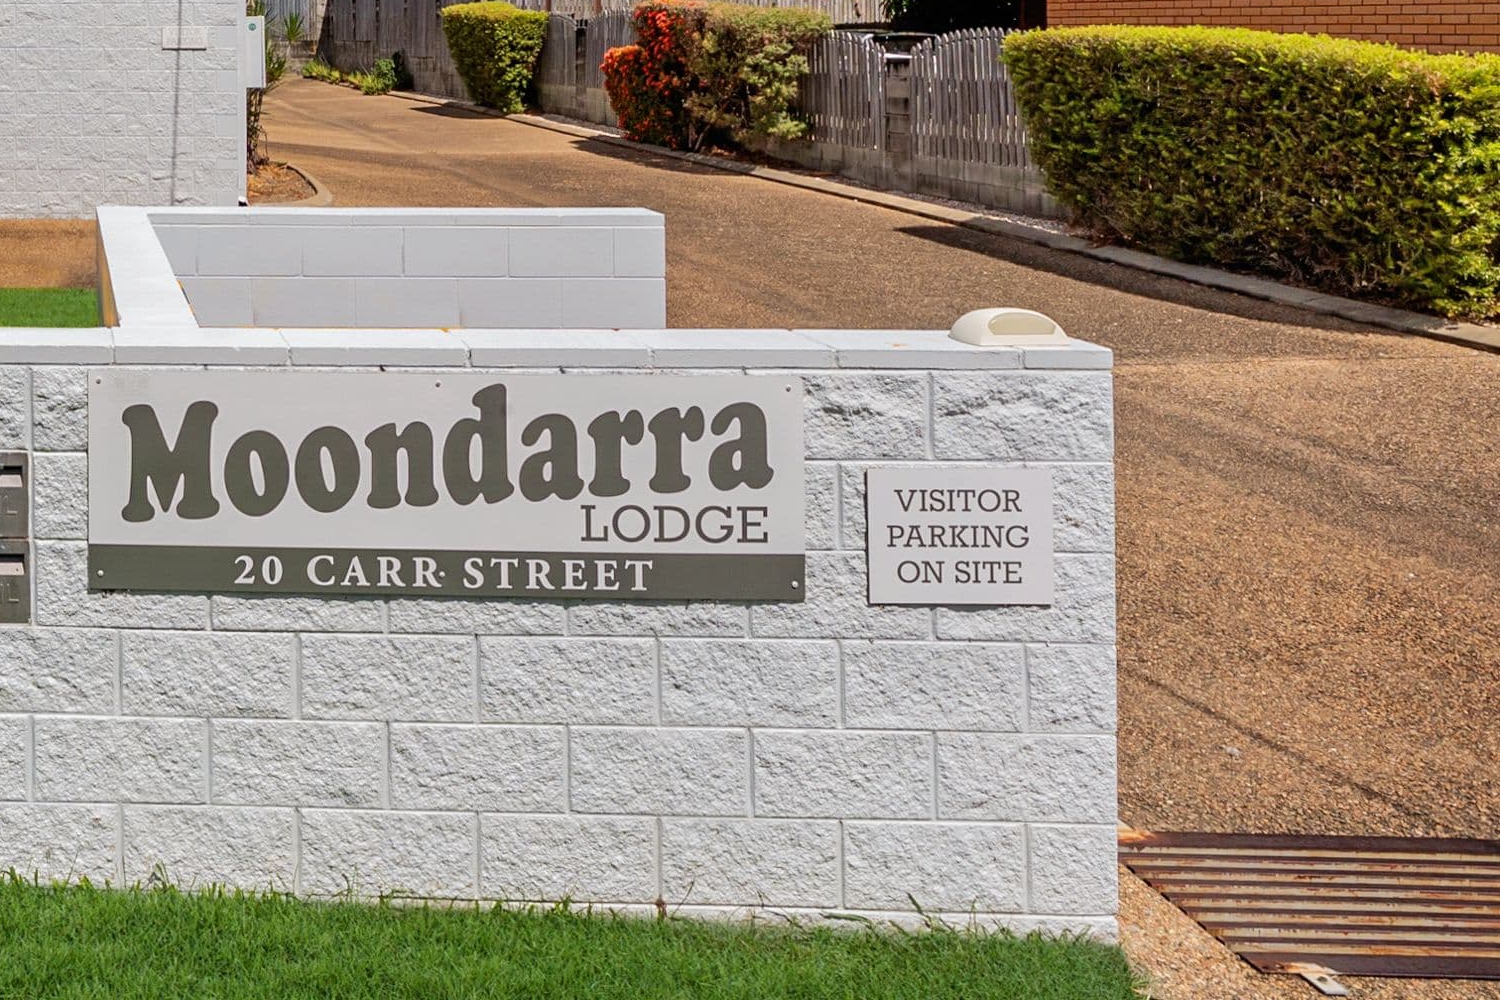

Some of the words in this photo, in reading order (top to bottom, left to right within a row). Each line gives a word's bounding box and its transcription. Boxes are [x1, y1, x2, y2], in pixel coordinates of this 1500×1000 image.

[121, 382, 775, 523] Moondarra
[894, 489, 1023, 512] VISITOR
[580, 504, 770, 544] LODGE
[886, 525, 1030, 548] PARKING
[233, 555, 284, 586] 20
[306, 555, 442, 589] CARR
[463, 558, 654, 592] STREET
[897, 560, 945, 584] ON
[955, 560, 1022, 584] SITE
